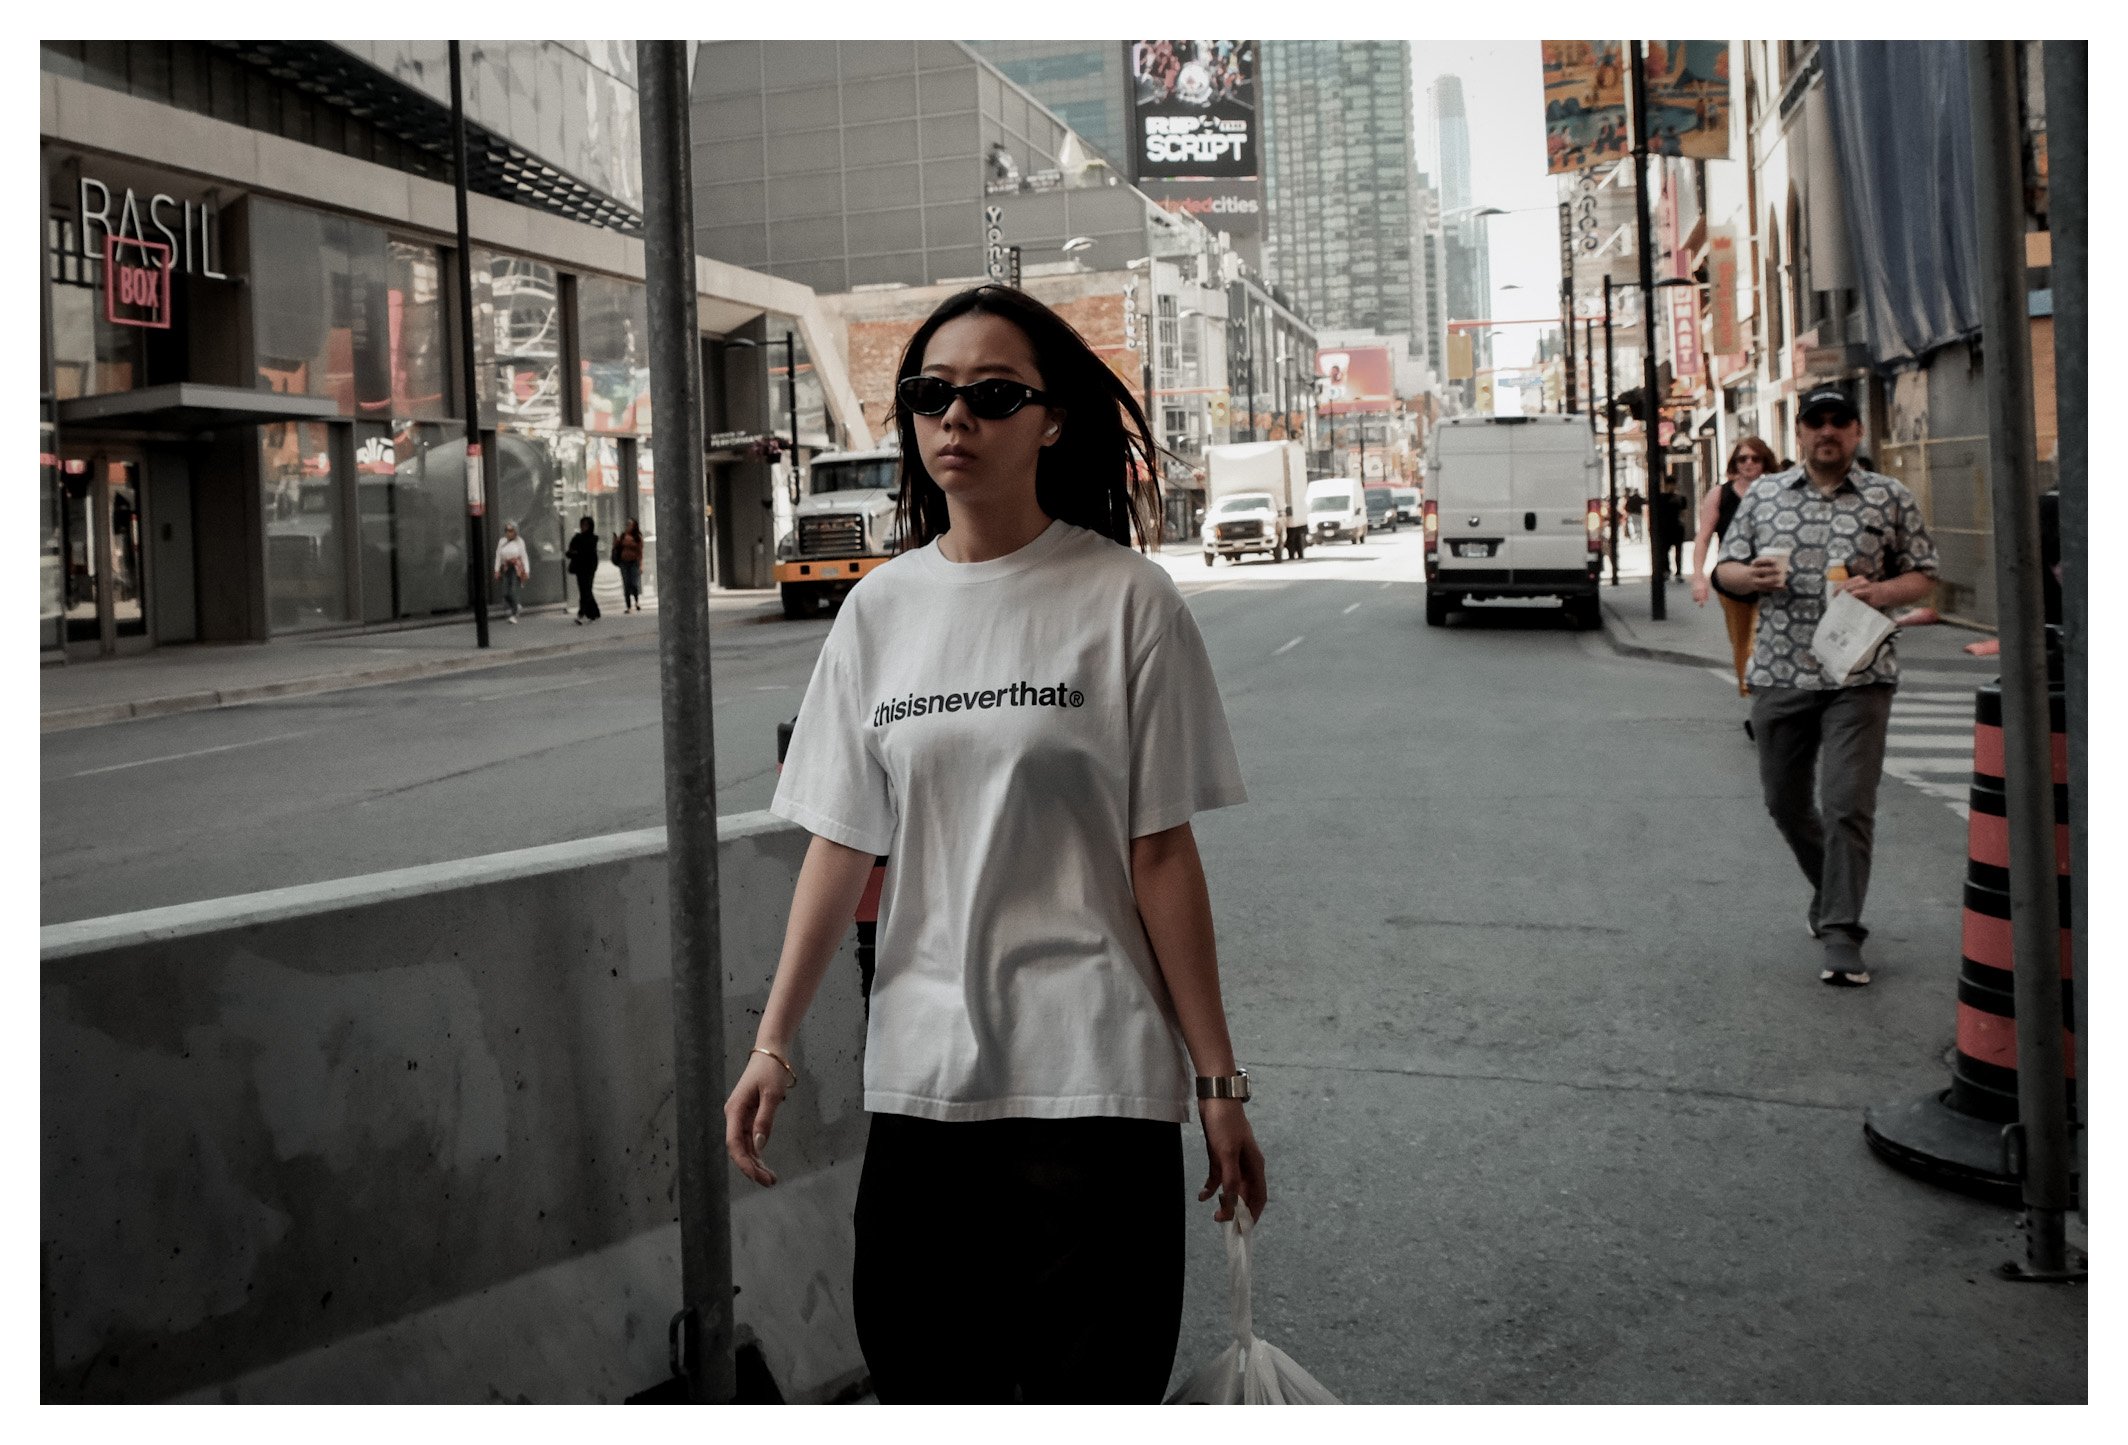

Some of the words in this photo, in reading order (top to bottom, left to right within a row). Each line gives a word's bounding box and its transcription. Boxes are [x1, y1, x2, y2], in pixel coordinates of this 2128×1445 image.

[1146, 132, 1248, 163] SCRIPT
[81, 177, 228, 281] BASIL
[120, 265, 160, 309] BOX
